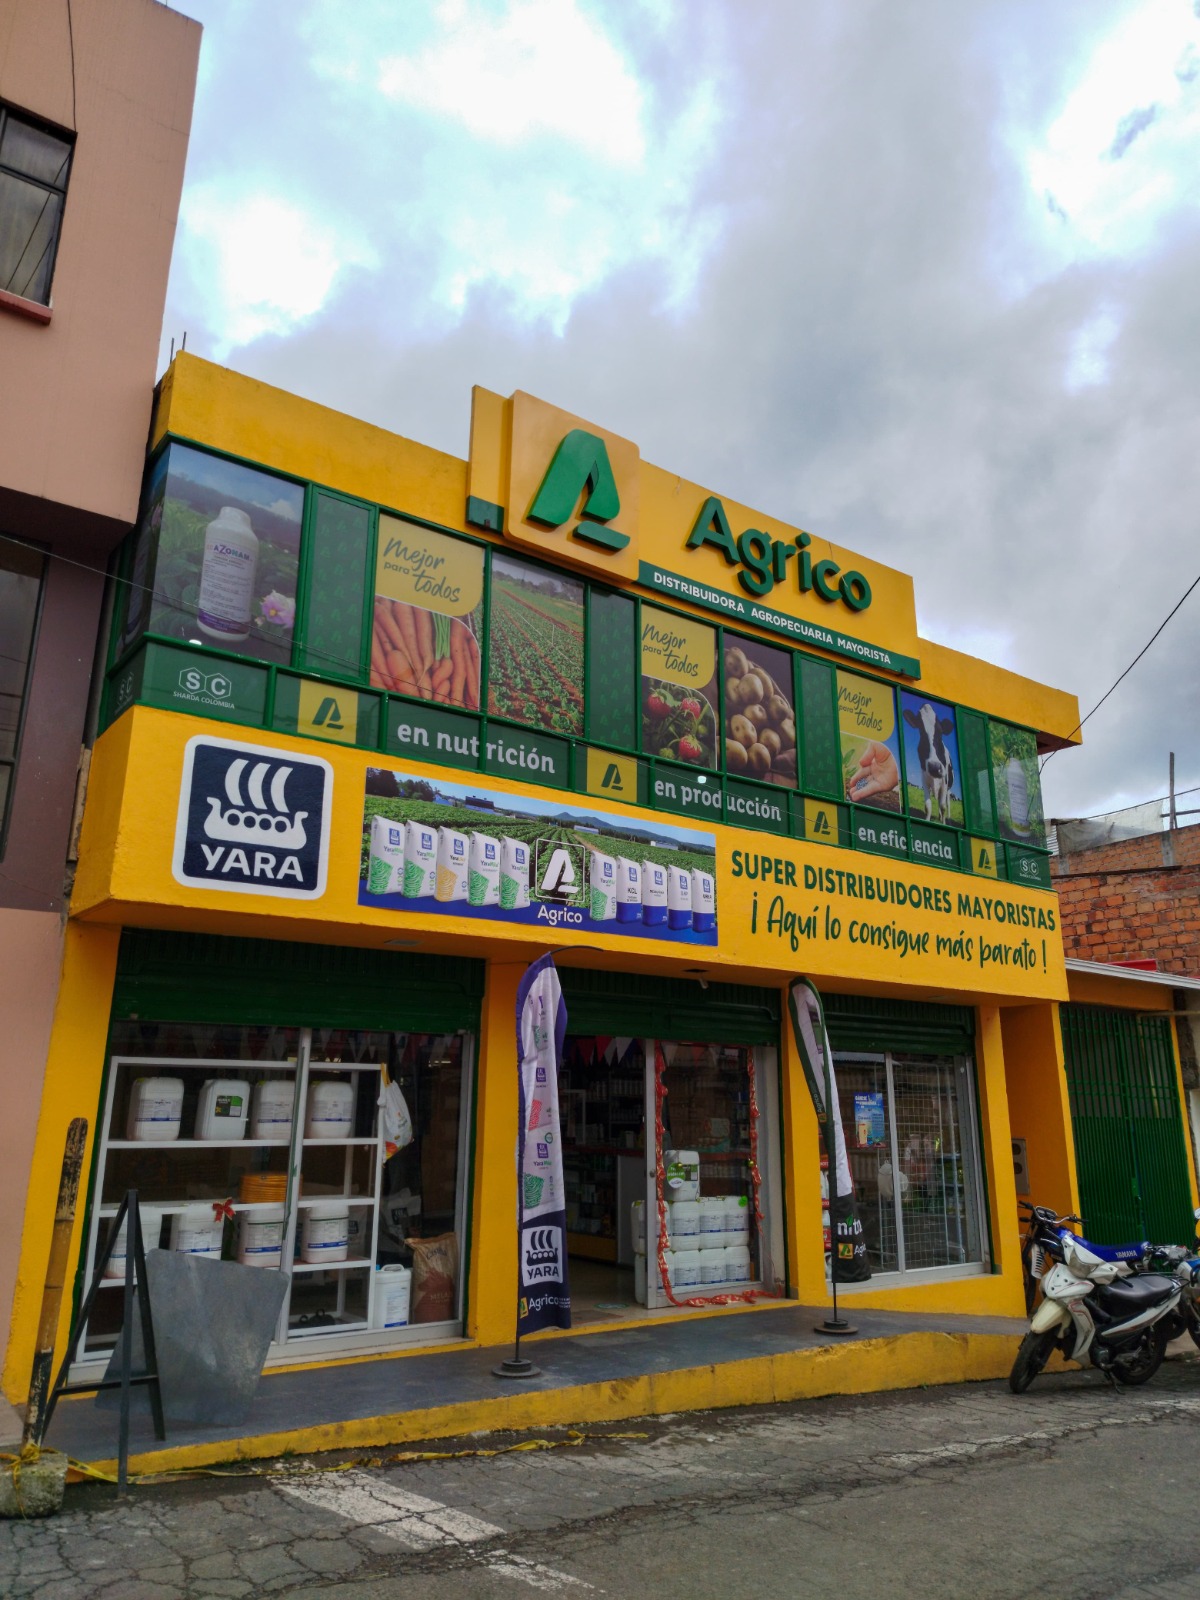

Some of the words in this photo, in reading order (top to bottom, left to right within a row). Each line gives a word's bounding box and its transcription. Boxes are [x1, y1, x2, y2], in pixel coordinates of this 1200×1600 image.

[383, 537, 445, 571] Mejor
[685, 495, 873, 612] Agrico
[383, 561, 410, 575] para
[412, 569, 461, 603] todos
[653, 571, 745, 614] DISTRIBUIDORA
[751, 607, 834, 645] AGROPECUARIA
[837, 637, 891, 665] MAYORISTA
[642, 623, 686, 652] Mejor
[643, 644, 662, 655] para
[663, 650, 699, 677] todos
[173, 691, 200, 702] SHARDA
[201, 697, 235, 709] COLOMBIA
[838, 685, 872, 711] Mejor
[854, 708, 883, 731] todos
[397, 723, 430, 747] en
[654, 779, 677, 799] en
[858, 826, 877, 844] en
[200, 843, 304, 883] YARA
[731, 850, 798, 888] SUPER
[803, 864, 952, 913] DISTRIBUIDORES
[957, 893, 1056, 932] MAYORISTAS
[537, 904, 583, 926] Agrico
[825, 904, 841, 941] lo
[848, 920, 930, 959] consigue
[936, 930, 974, 962] más
[1115, 1249, 1138, 1259] YAMAHA
[527, 1265, 560, 1280] YARA
[528, 1294, 559, 1312] Agrico
